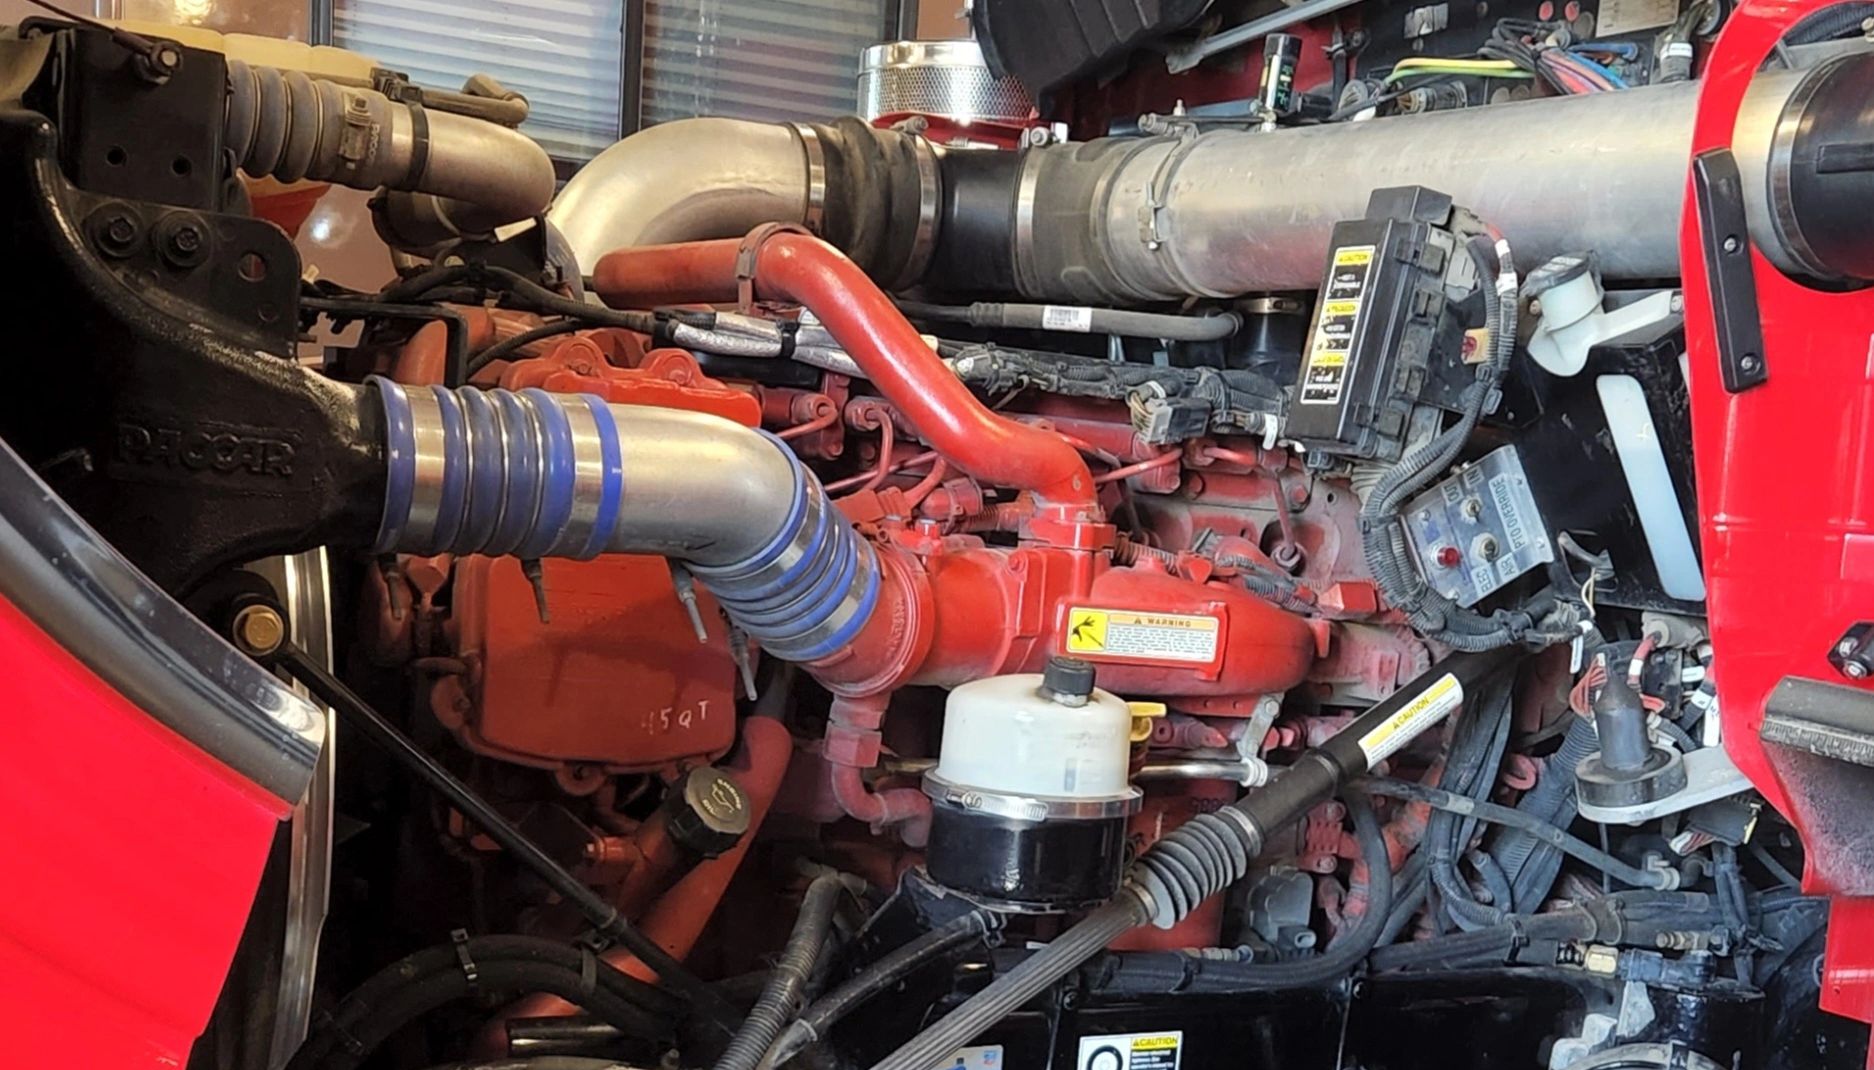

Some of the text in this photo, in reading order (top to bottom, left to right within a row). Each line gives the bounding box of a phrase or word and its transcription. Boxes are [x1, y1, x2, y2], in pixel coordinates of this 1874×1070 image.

[118, 423, 297, 475] PACCAR
[1467, 469, 1482, 484] IN
[1443, 484, 1460, 501] OUT
[1493, 477, 1526, 549] PTO OVERRIDE
[1502, 561, 1516, 576] AIR
[1476, 569, 1492, 593] ELEC
[1147, 618, 1192, 628] WARNING
[1397, 696, 1430, 724] CAUTION
[1139, 1036, 1178, 1047] CAUTION
